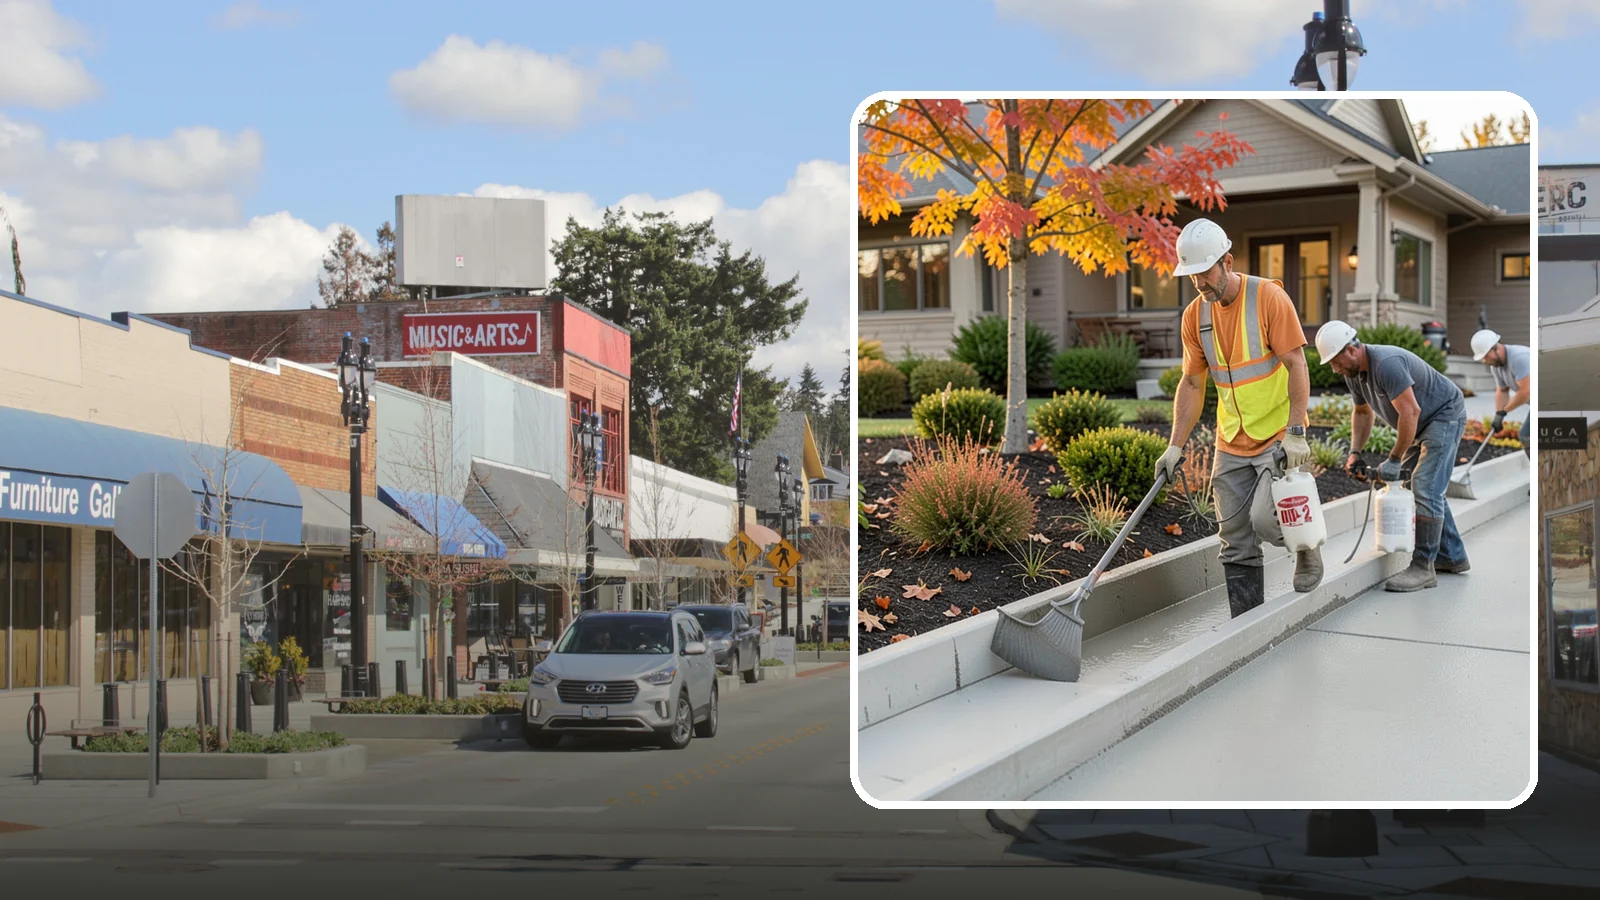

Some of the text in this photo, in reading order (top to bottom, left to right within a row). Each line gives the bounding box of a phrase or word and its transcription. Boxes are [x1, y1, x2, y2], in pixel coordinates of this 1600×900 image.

[409, 322, 519, 349] MUSIC&ARTS
[0, 471, 121, 519] Furniture Gal
